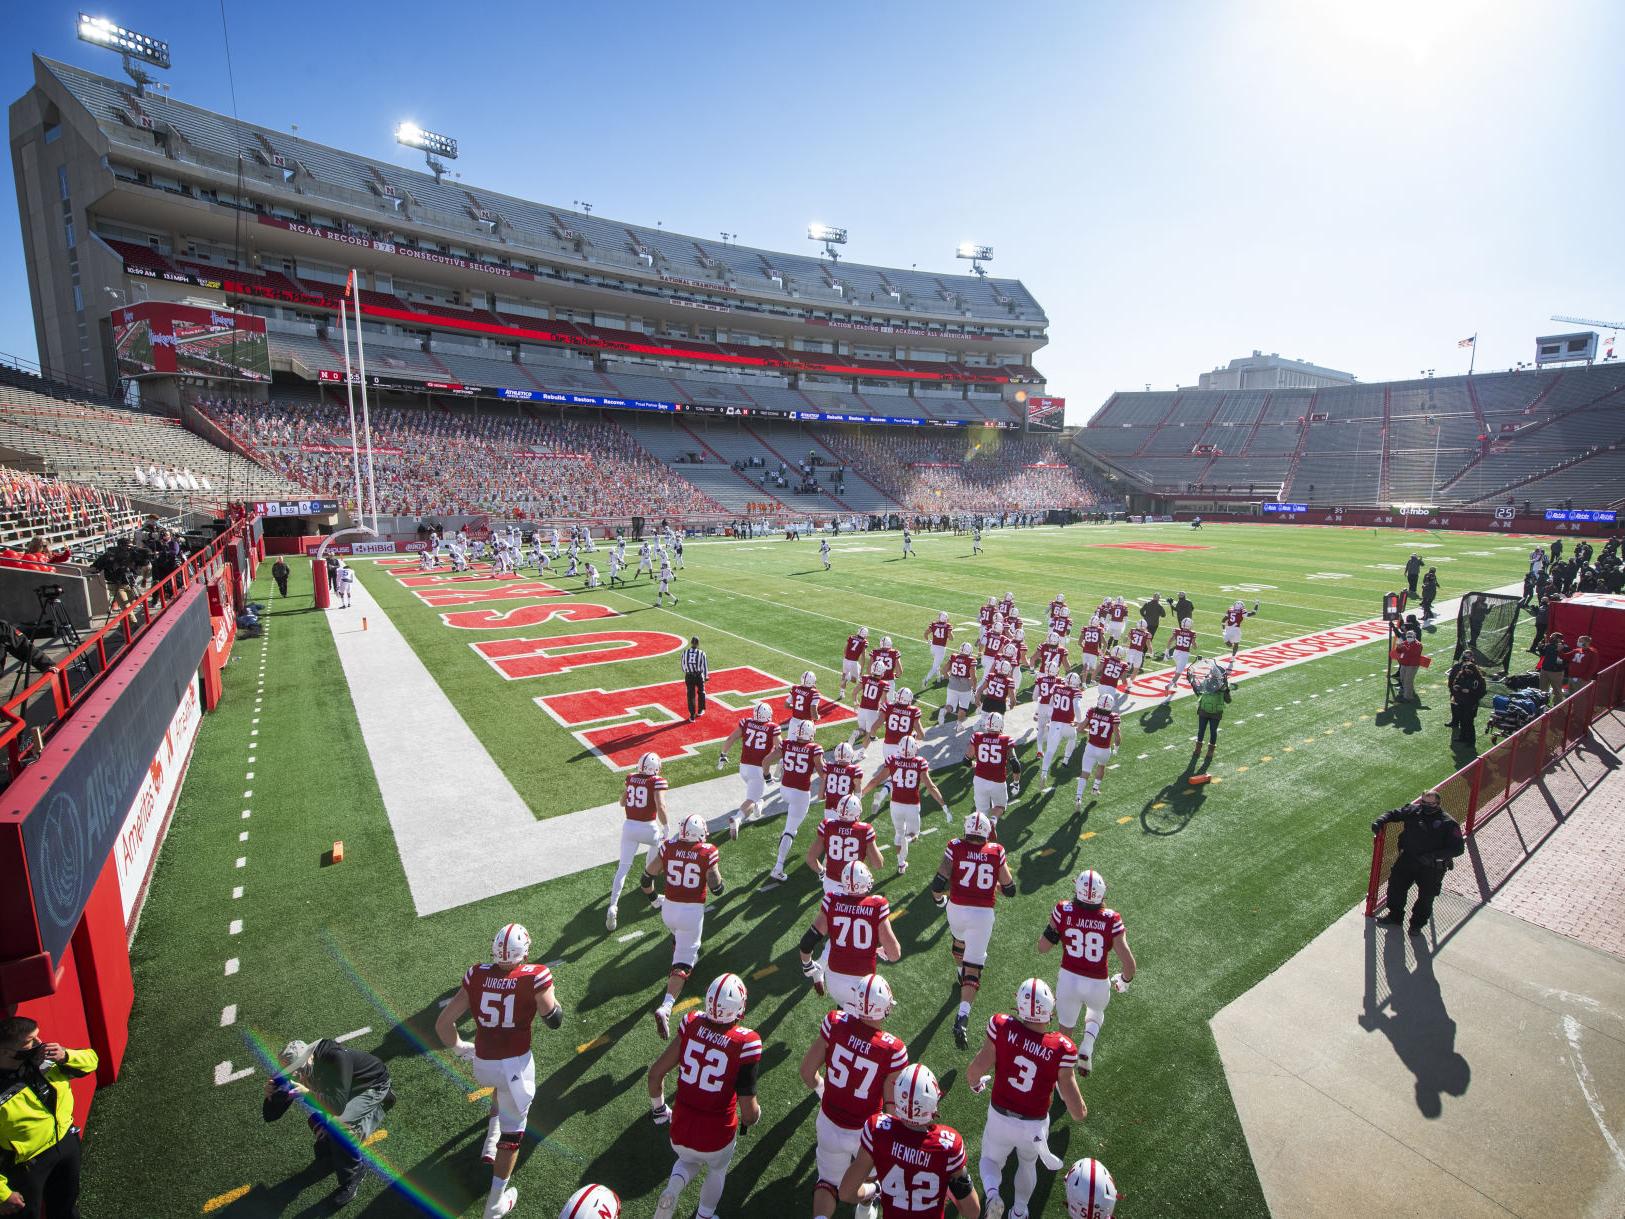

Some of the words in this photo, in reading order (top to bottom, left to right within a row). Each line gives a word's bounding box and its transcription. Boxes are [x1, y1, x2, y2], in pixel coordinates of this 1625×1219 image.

[289, 223, 321, 237] NCAA
[327, 231, 369, 247] RECORD
[399, 248, 466, 268] CONSECUTIVE
[469, 263, 511, 277] SELLOUTS
[144, 270, 156, 278] AM
[173, 274, 189, 283] MPH
[829, 321, 851, 329] NATION
[853, 324, 879, 332] LEADING
[1498, 508, 1512, 518] 25
[981, 610, 990, 621] 31
[1115, 608, 1120, 617] 0
[1229, 612, 1236, 623] 5
[934, 628, 945, 639] 41
[1085, 631, 1099, 643] 29
[1131, 634, 1143, 647] 31
[1176, 636, 1191, 648] 85
[850, 639, 860, 651] 7
[988, 637, 1001, 650] 18
[951, 662, 967, 677] 63
[1104, 663, 1122, 679] 25
[863, 683, 879, 699] 10
[988, 679, 1005, 698] 55
[794, 694, 804, 711] 2
[1053, 695, 1071, 711] 90
[888, 714, 911, 733] 69
[1089, 719, 1111, 739] 37
[744, 729, 767, 750] 72
[783, 751, 809, 773] 55
[977, 743, 1002, 764] 65
[826, 773, 851, 795] 88
[892, 768, 918, 789] 48
[626, 785, 648, 808] 39
[122, 786, 154, 876] Ameritas
[675, 849, 699, 860] WILSON
[828, 835, 860, 862] 82
[966, 851, 988, 861] JAIMES
[666, 860, 701, 889] 56
[959, 861, 994, 890] 76
[832, 916, 873, 950] 70
[1075, 918, 1107, 931] JACKSON
[1064, 928, 1105, 963] 38
[482, 977, 518, 990] JURGENS
[477, 991, 516, 1029] 51
[696, 1025, 732, 1048] NEWSOM
[847, 1035, 872, 1055] PIPER
[1007, 1030, 1018, 1046] W.
[1022, 1038, 1054, 1061] HONAS
[679, 1039, 729, 1093] 52
[827, 1043, 880, 1100] 57
[1008, 1055, 1036, 1093] 3
[891, 1141, 932, 1167] HENRICH
[881, 1164, 941, 1212] 42
